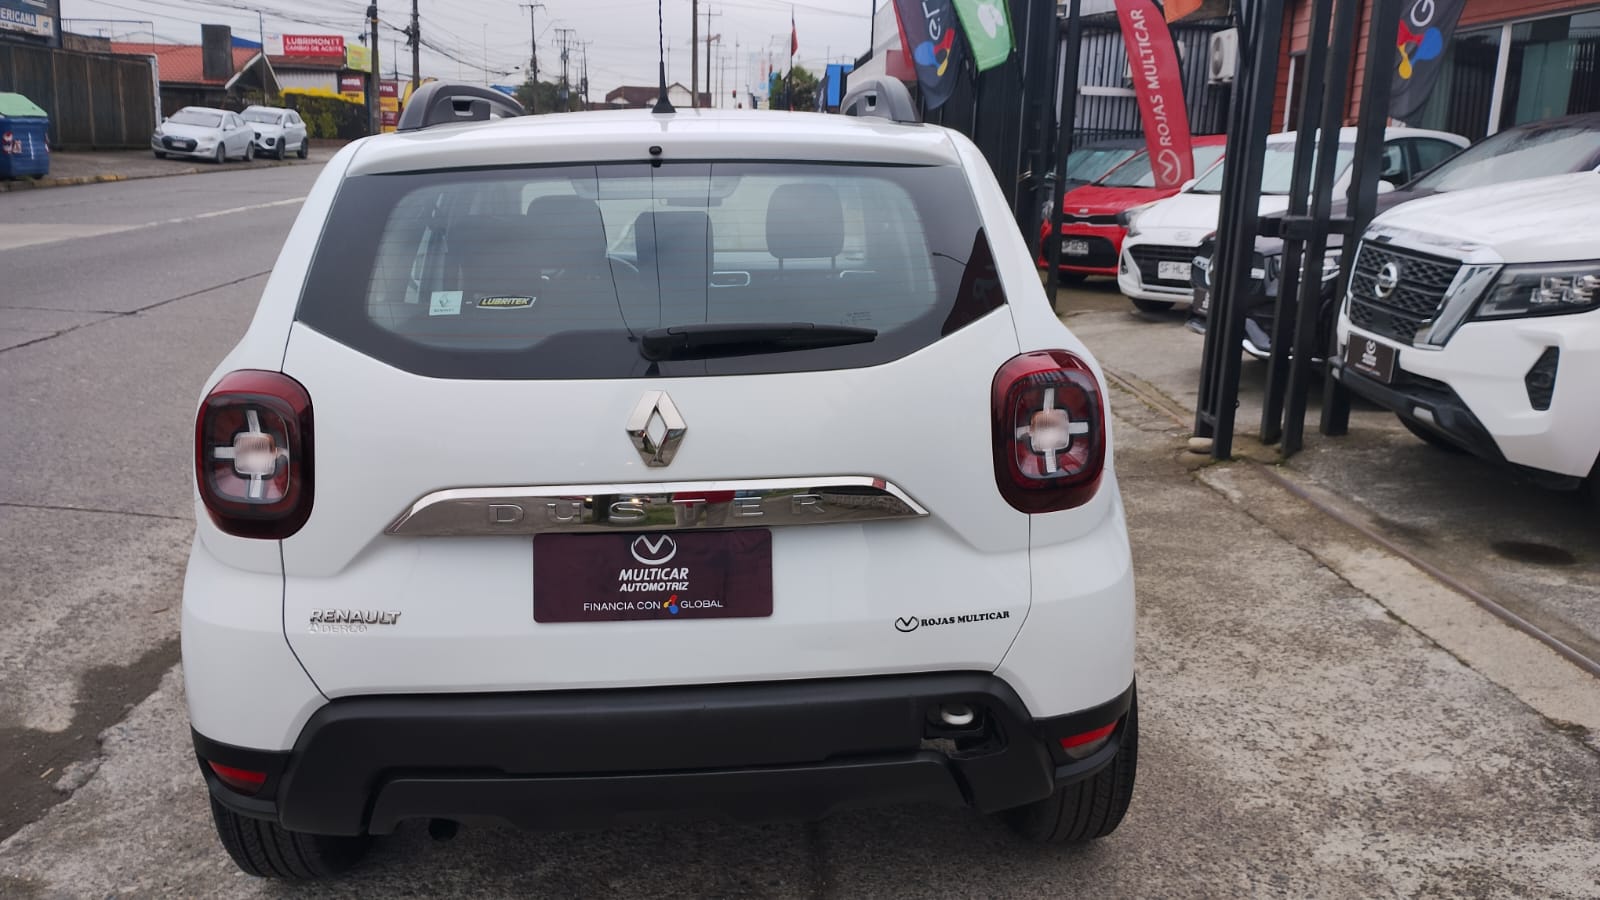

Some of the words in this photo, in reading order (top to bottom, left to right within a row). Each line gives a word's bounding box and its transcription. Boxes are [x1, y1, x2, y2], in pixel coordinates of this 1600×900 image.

[1130, 9, 1160, 89] MULTICAR
[1150, 95, 1172, 146] ROJAS
[481, 297, 529, 305] LUBRITEK
[488, 494, 826, 524] DUSTER
[619, 567, 689, 581] MULTICAR
[619, 582, 689, 592] AUTOMOTRIZ
[583, 601, 635, 611] FINANCIA
[637, 601, 661, 610] CON
[680, 600, 724, 609] GLOBAL
[309, 608, 402, 625] RENAULT
[921, 616, 955, 627] ROJAS
[957, 611, 1009, 623] MULTICAR
